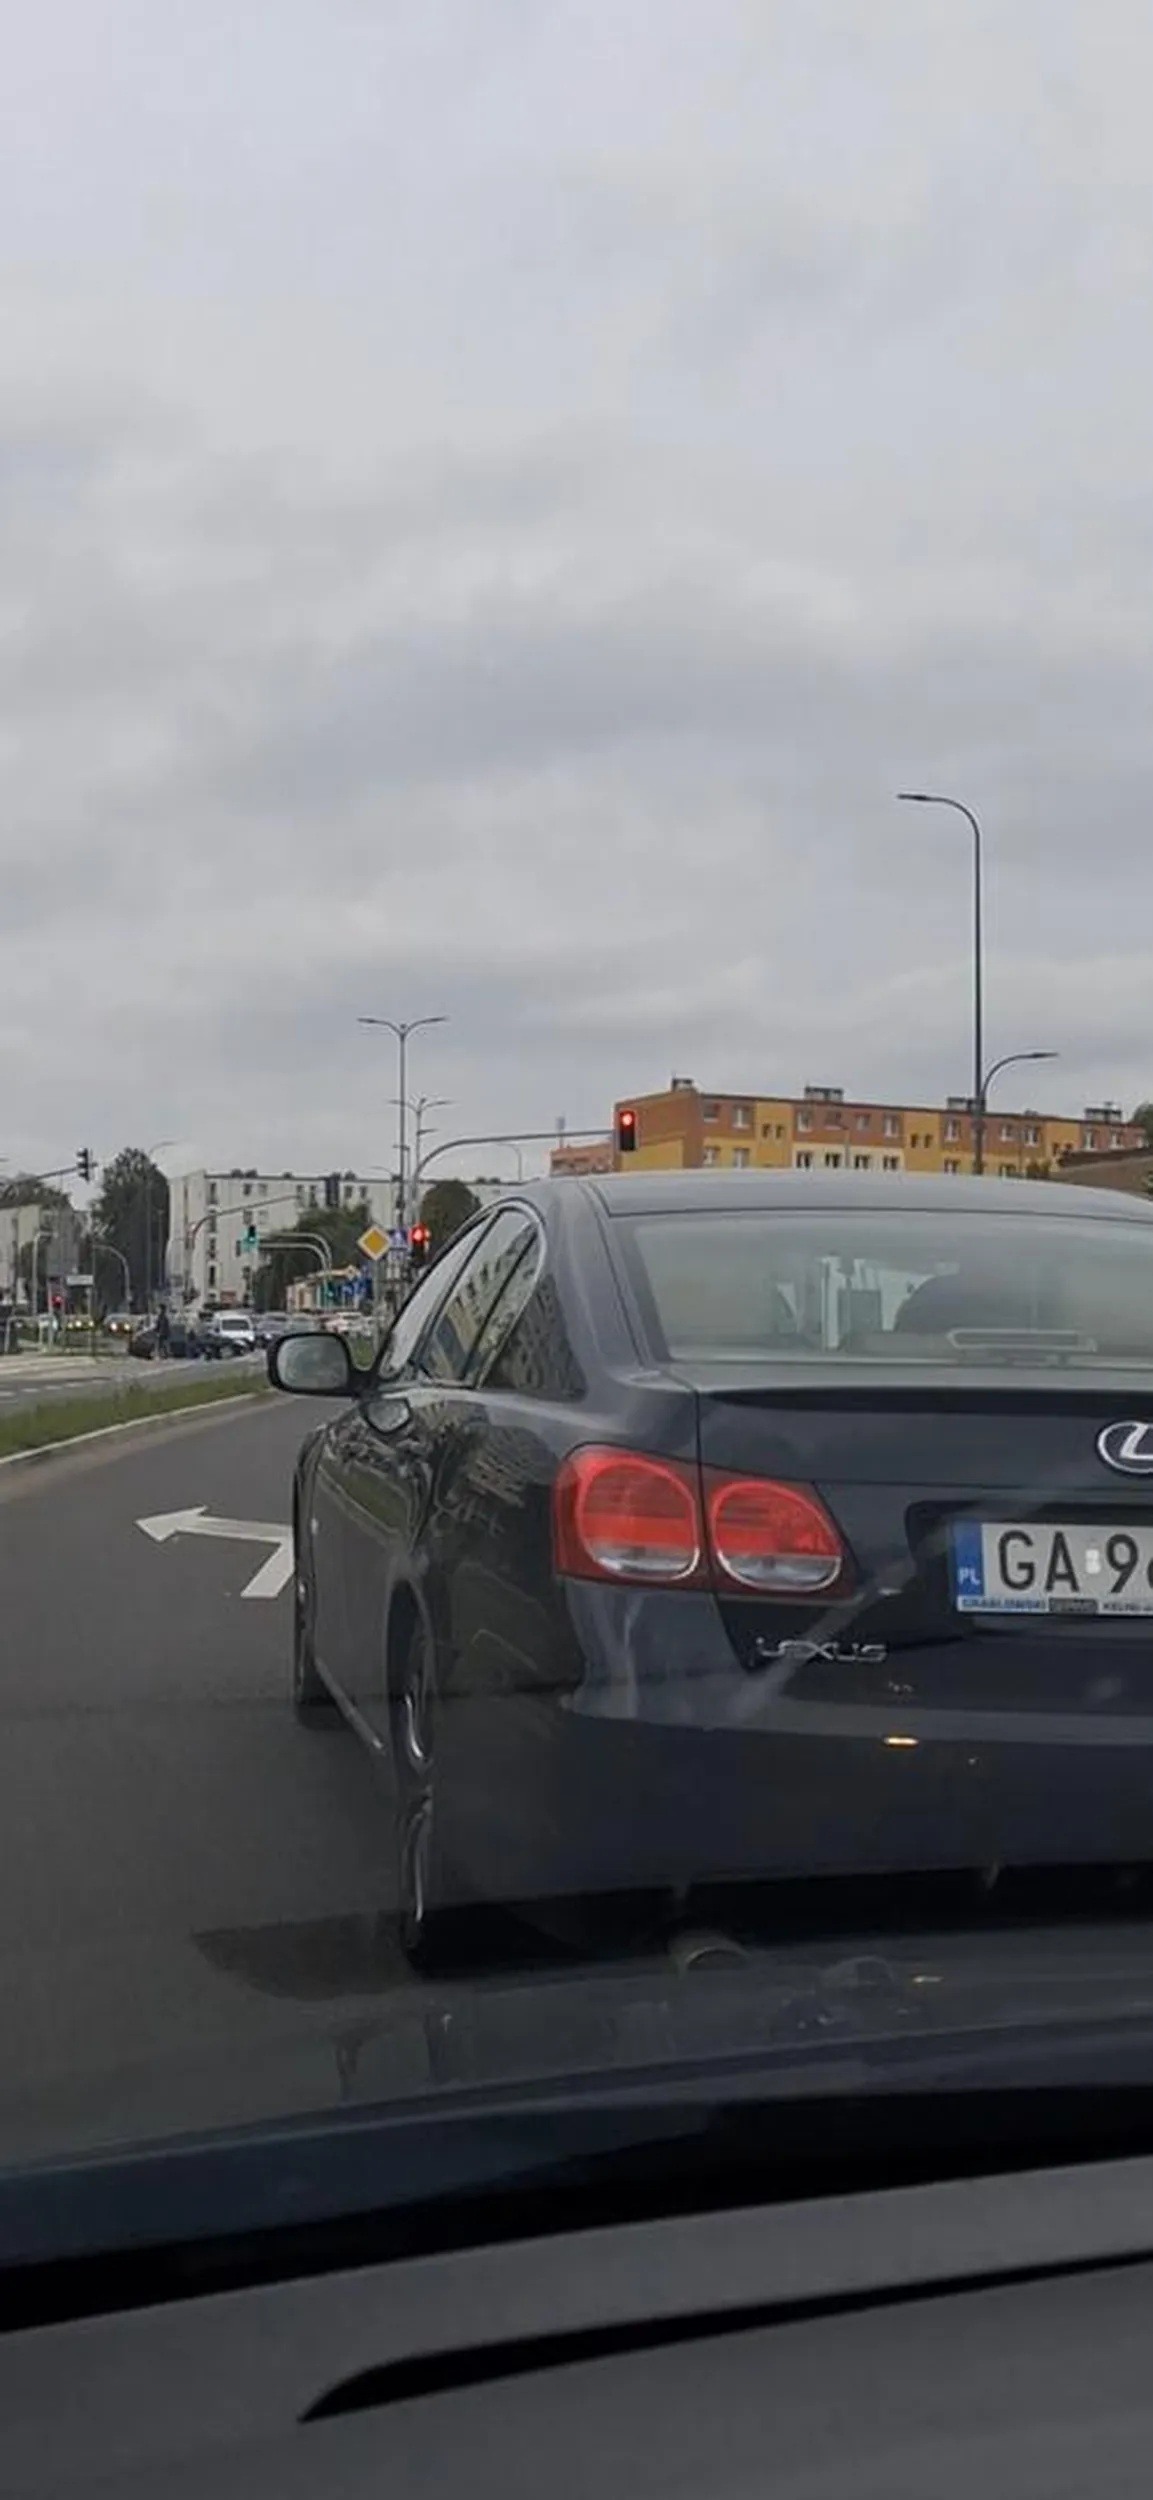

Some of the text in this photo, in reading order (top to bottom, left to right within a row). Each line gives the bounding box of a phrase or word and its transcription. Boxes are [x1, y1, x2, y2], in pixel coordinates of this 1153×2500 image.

[998, 1529, 1153, 1593] GA 9
[958, 1567, 981, 1585] PL
[755, 1636, 888, 1662] LEXUS
